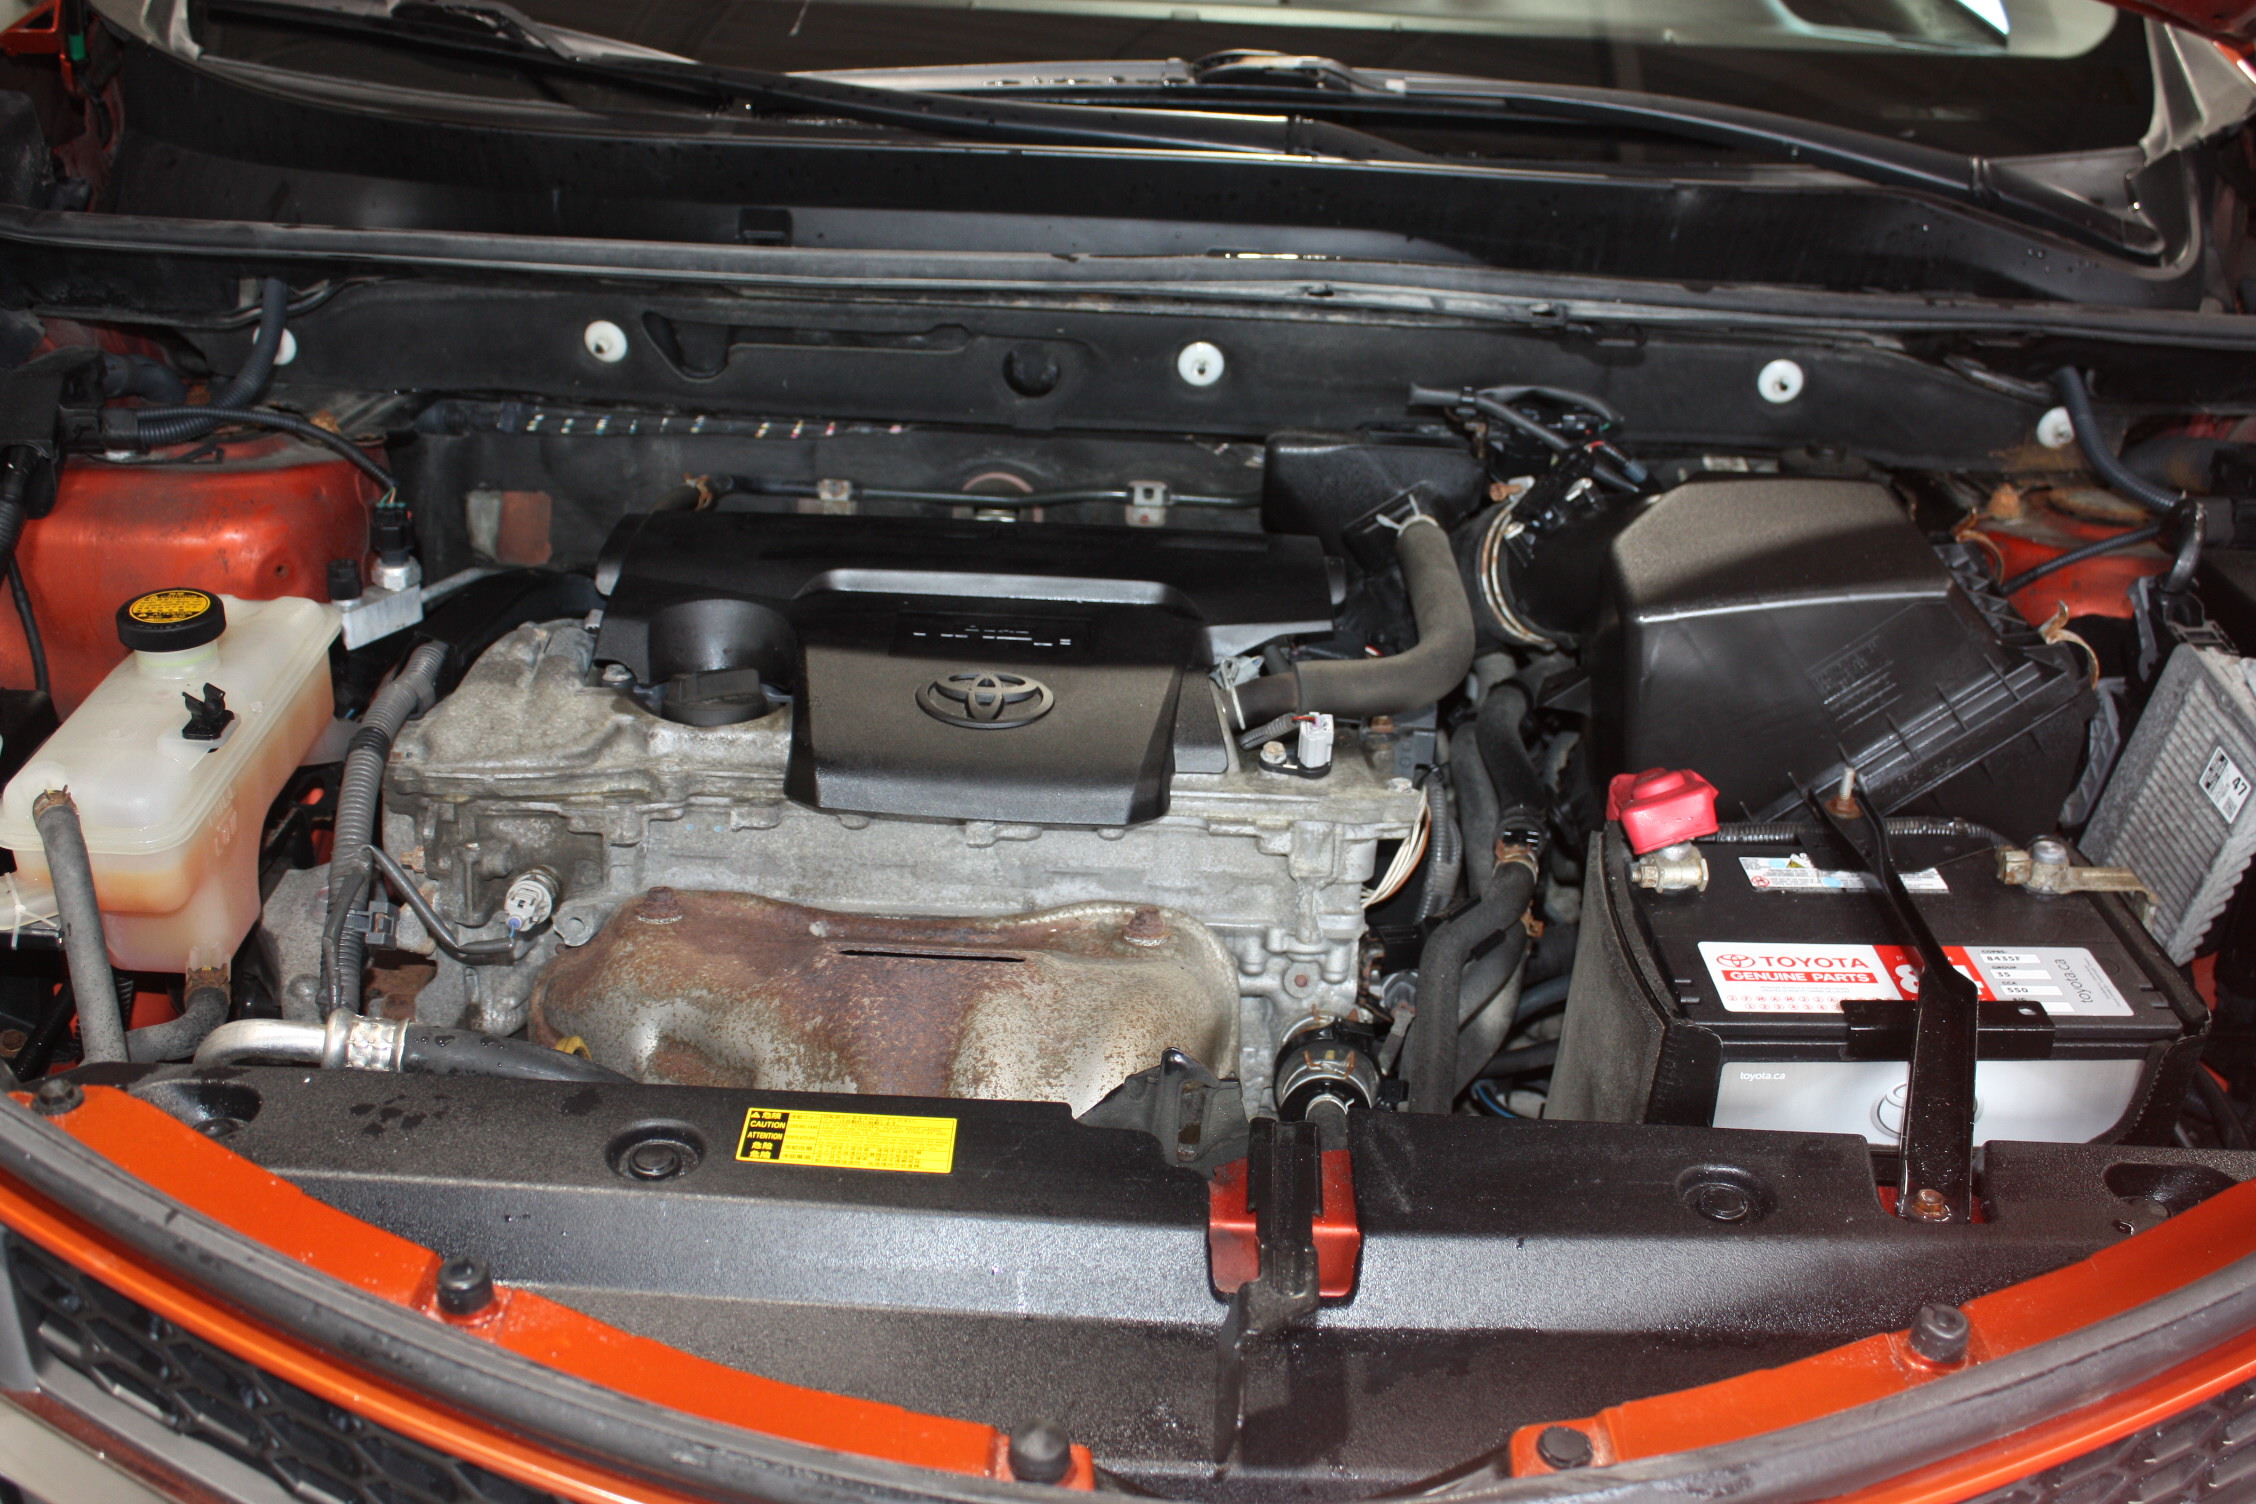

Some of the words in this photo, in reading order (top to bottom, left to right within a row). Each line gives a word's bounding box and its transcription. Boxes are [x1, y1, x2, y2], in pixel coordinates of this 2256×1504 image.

[2231, 776, 2248, 796] 47
[1759, 956, 1870, 969] TOYOTA
[1730, 971, 1807, 982] GENUINE
[1811, 973, 1870, 983] PARTS
[2055, 958, 2093, 1004] toyota.ca
[1740, 1071, 1786, 1081] toyota.ca
[750, 1120, 786, 1129] CAUTION
[747, 1131, 783, 1140] ATTENTION
